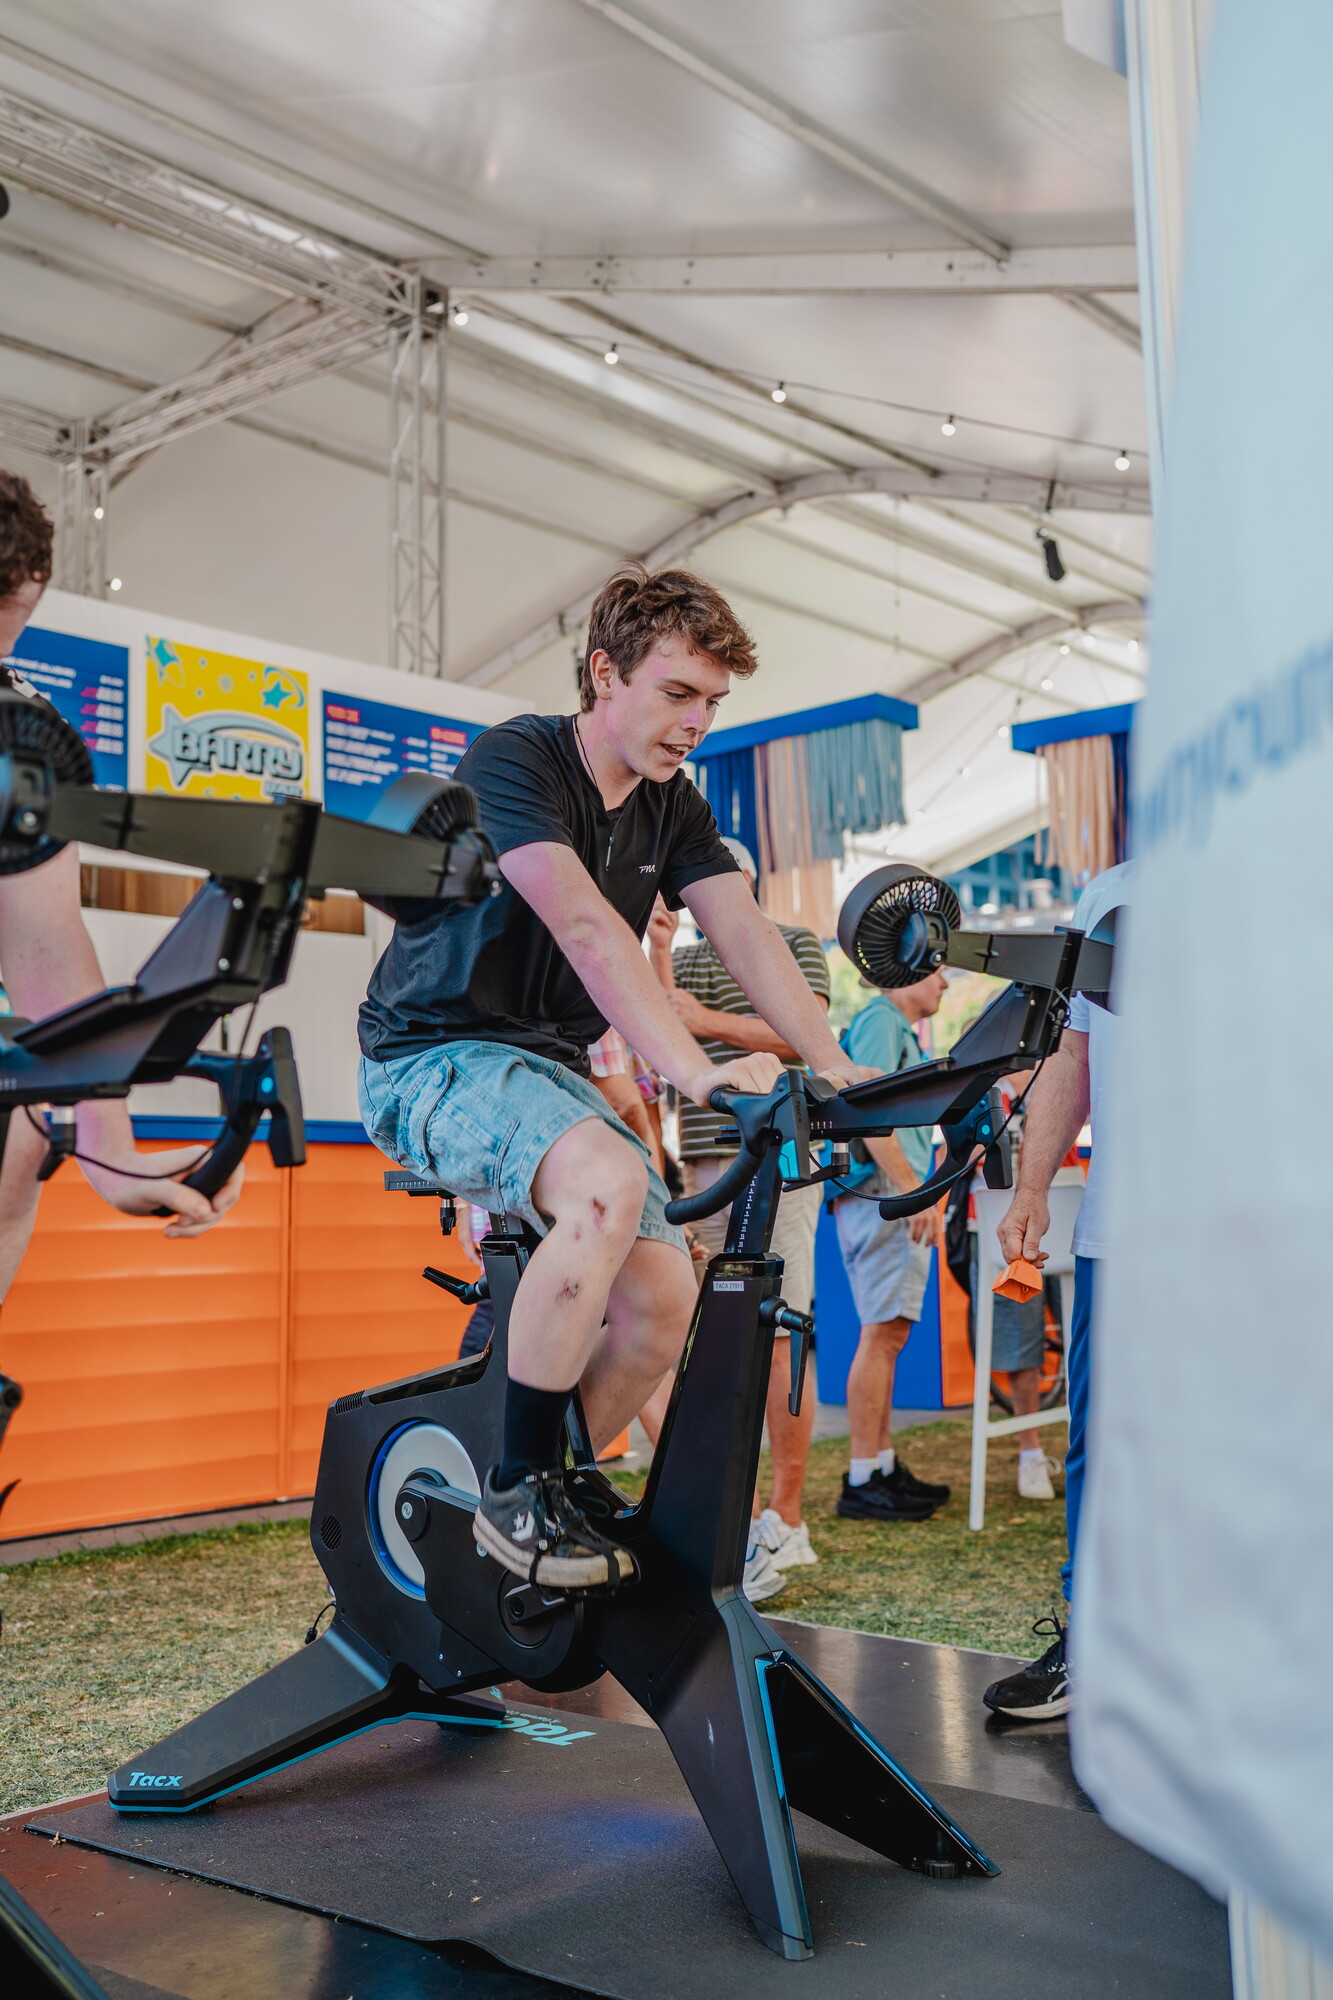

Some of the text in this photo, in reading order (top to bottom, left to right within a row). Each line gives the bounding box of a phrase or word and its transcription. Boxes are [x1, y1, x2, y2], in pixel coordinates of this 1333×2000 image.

[172, 726, 303, 780] BARRY
[500, 1715, 597, 1746] Tac
[129, 1771, 183, 1787] Tacx
